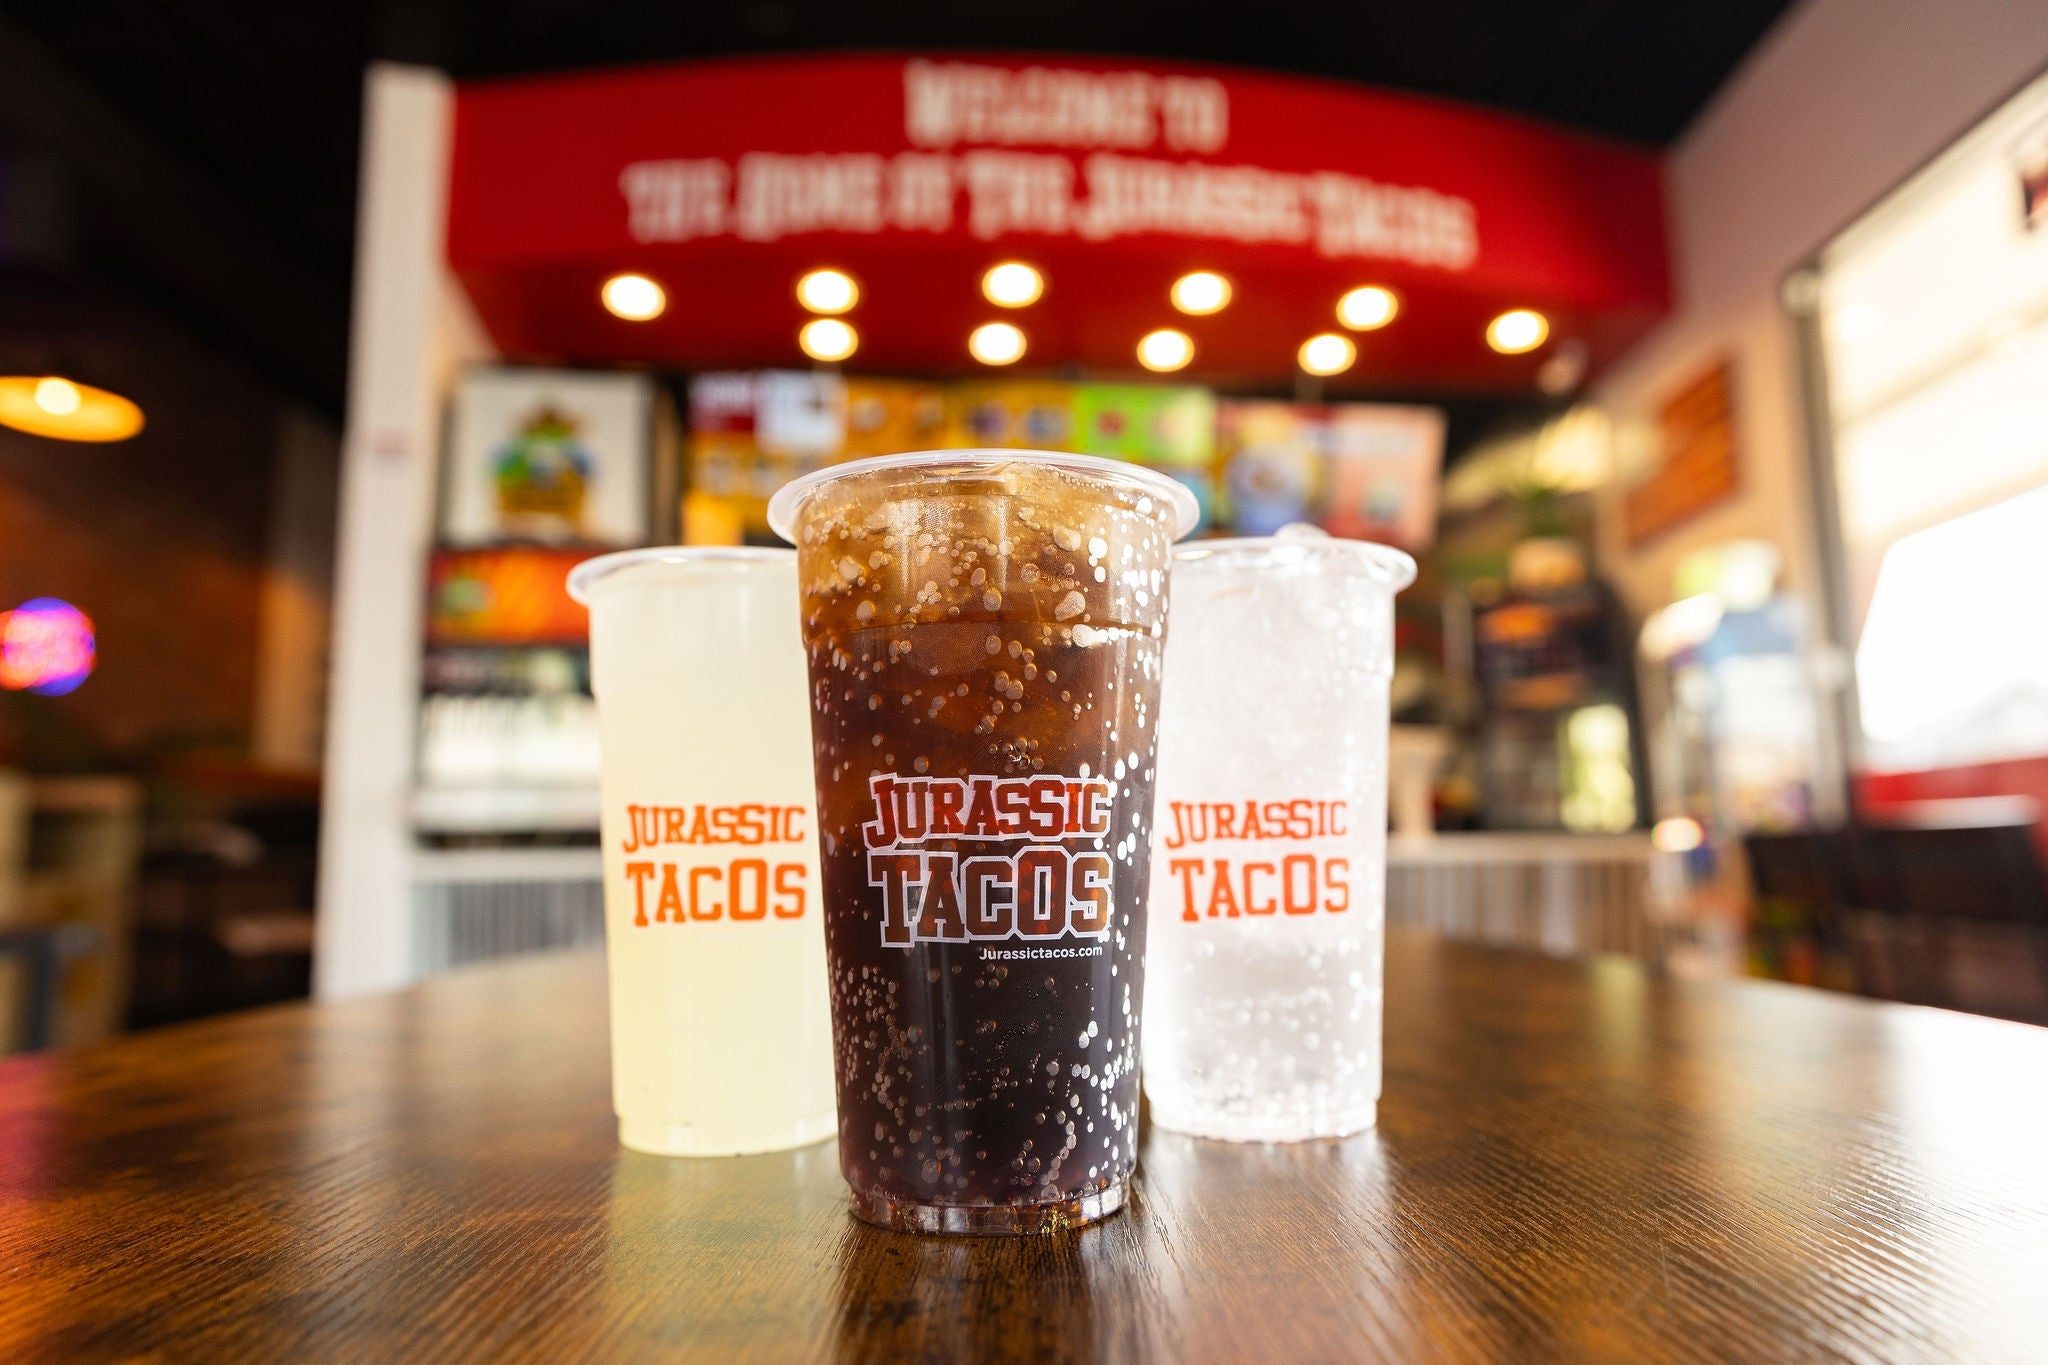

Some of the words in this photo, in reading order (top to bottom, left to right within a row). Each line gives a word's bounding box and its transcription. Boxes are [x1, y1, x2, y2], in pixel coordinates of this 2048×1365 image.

[623, 804, 806, 853] JURASSIC
[862, 772, 1112, 850] JURASSIC
[1165, 800, 1347, 849] JURASSIC
[626, 858, 808, 927] TACOS
[867, 846, 1113, 948] TACOS
[1169, 854, 1349, 922] TACOS
[979, 945, 1103, 960] Jurassictacos.com
